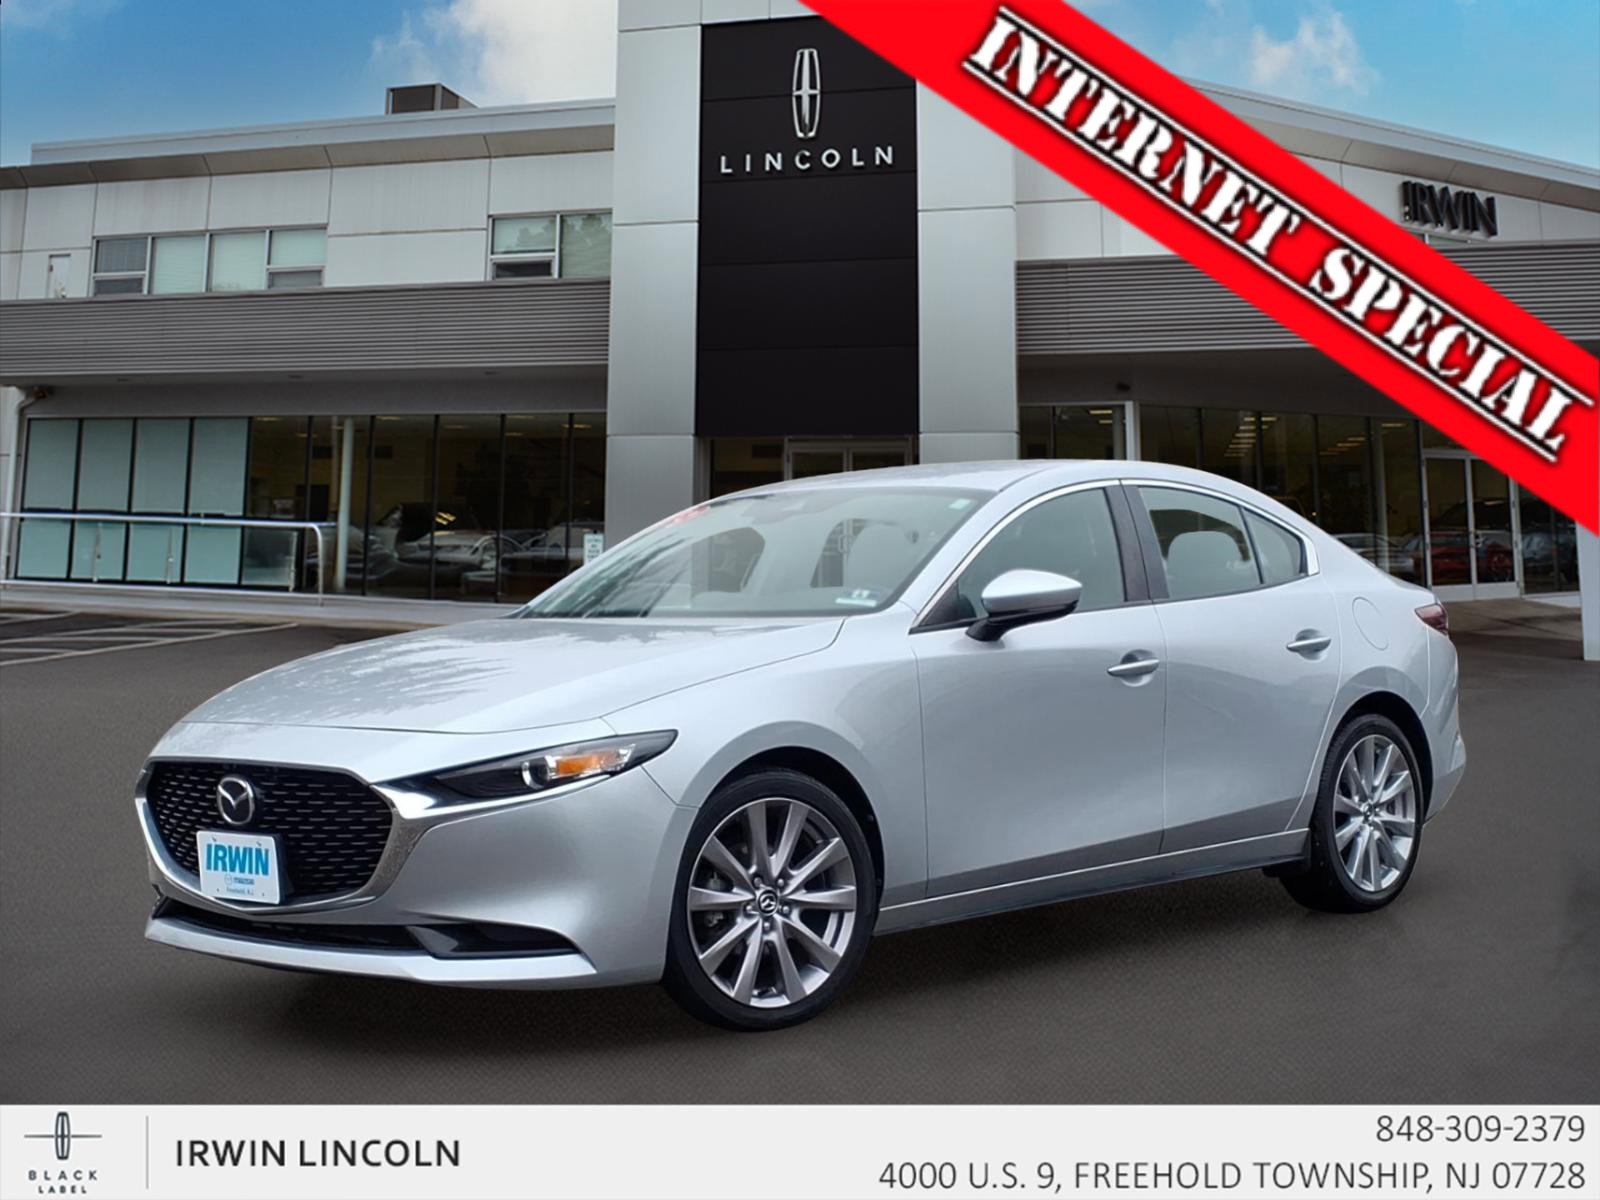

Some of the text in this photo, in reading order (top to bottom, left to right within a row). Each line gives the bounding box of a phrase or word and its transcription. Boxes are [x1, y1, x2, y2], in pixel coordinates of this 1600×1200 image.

[720, 146, 893, 174] LINCOLN
[1402, 181, 1498, 237] IRWIN
[206, 843, 269, 876] IRWIN
